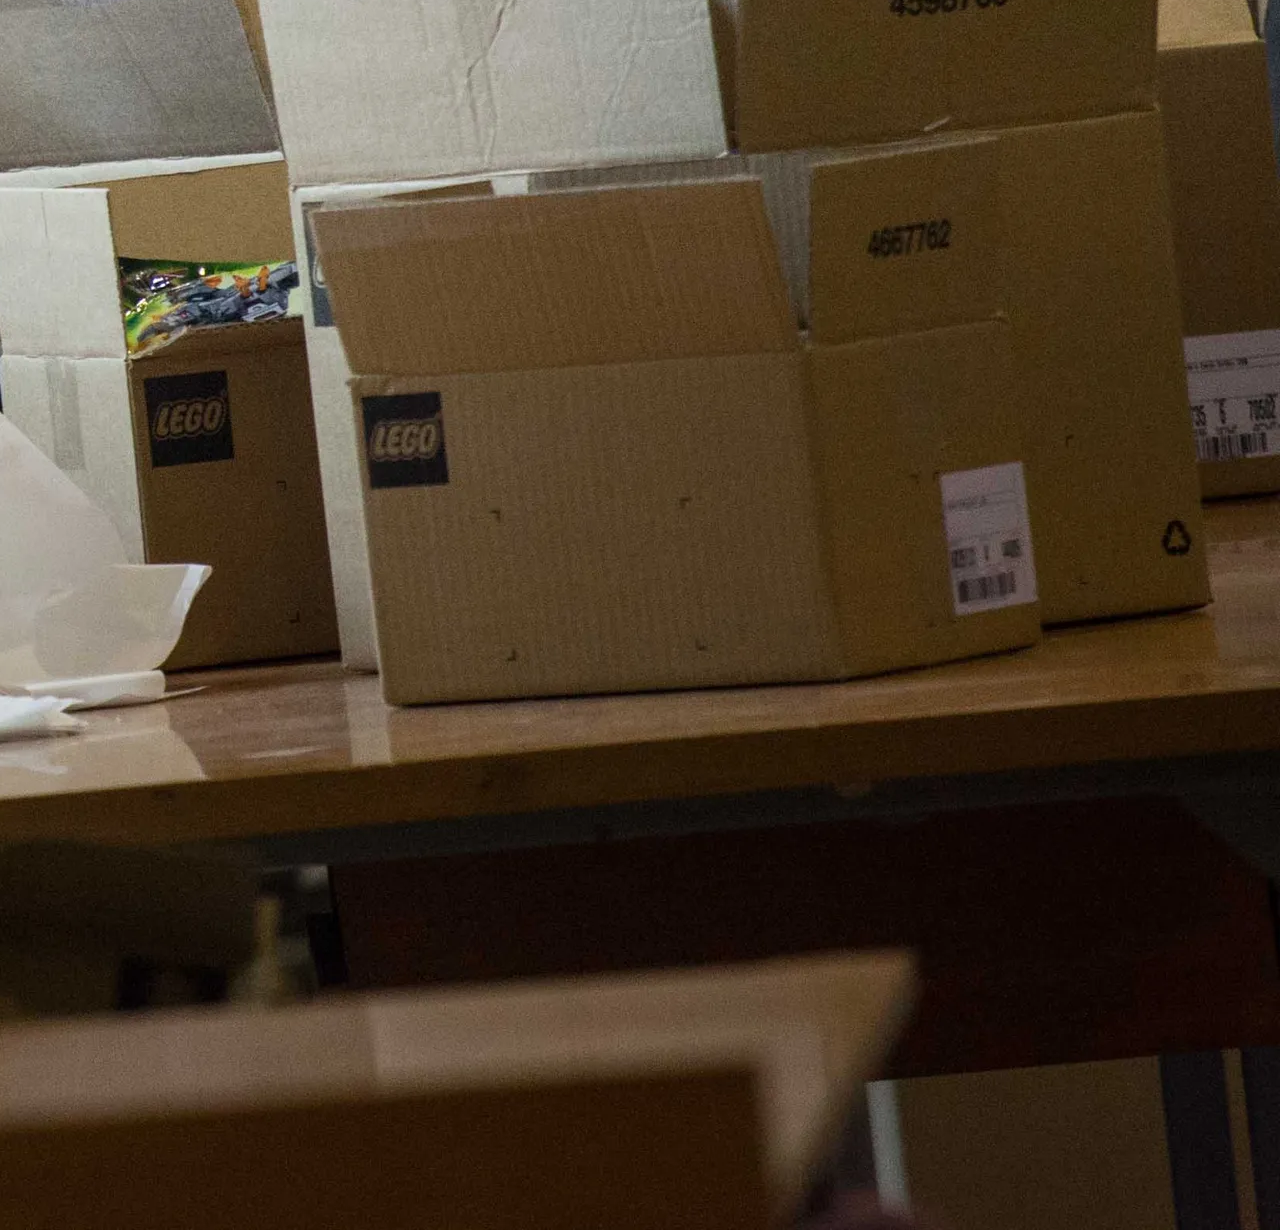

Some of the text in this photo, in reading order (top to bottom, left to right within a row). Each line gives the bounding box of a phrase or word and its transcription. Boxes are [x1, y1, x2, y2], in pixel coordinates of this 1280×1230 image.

[867, 218, 953, 257] 4667762
[155, 400, 225, 439] LEGO
[369, 420, 441, 459] LEGO
